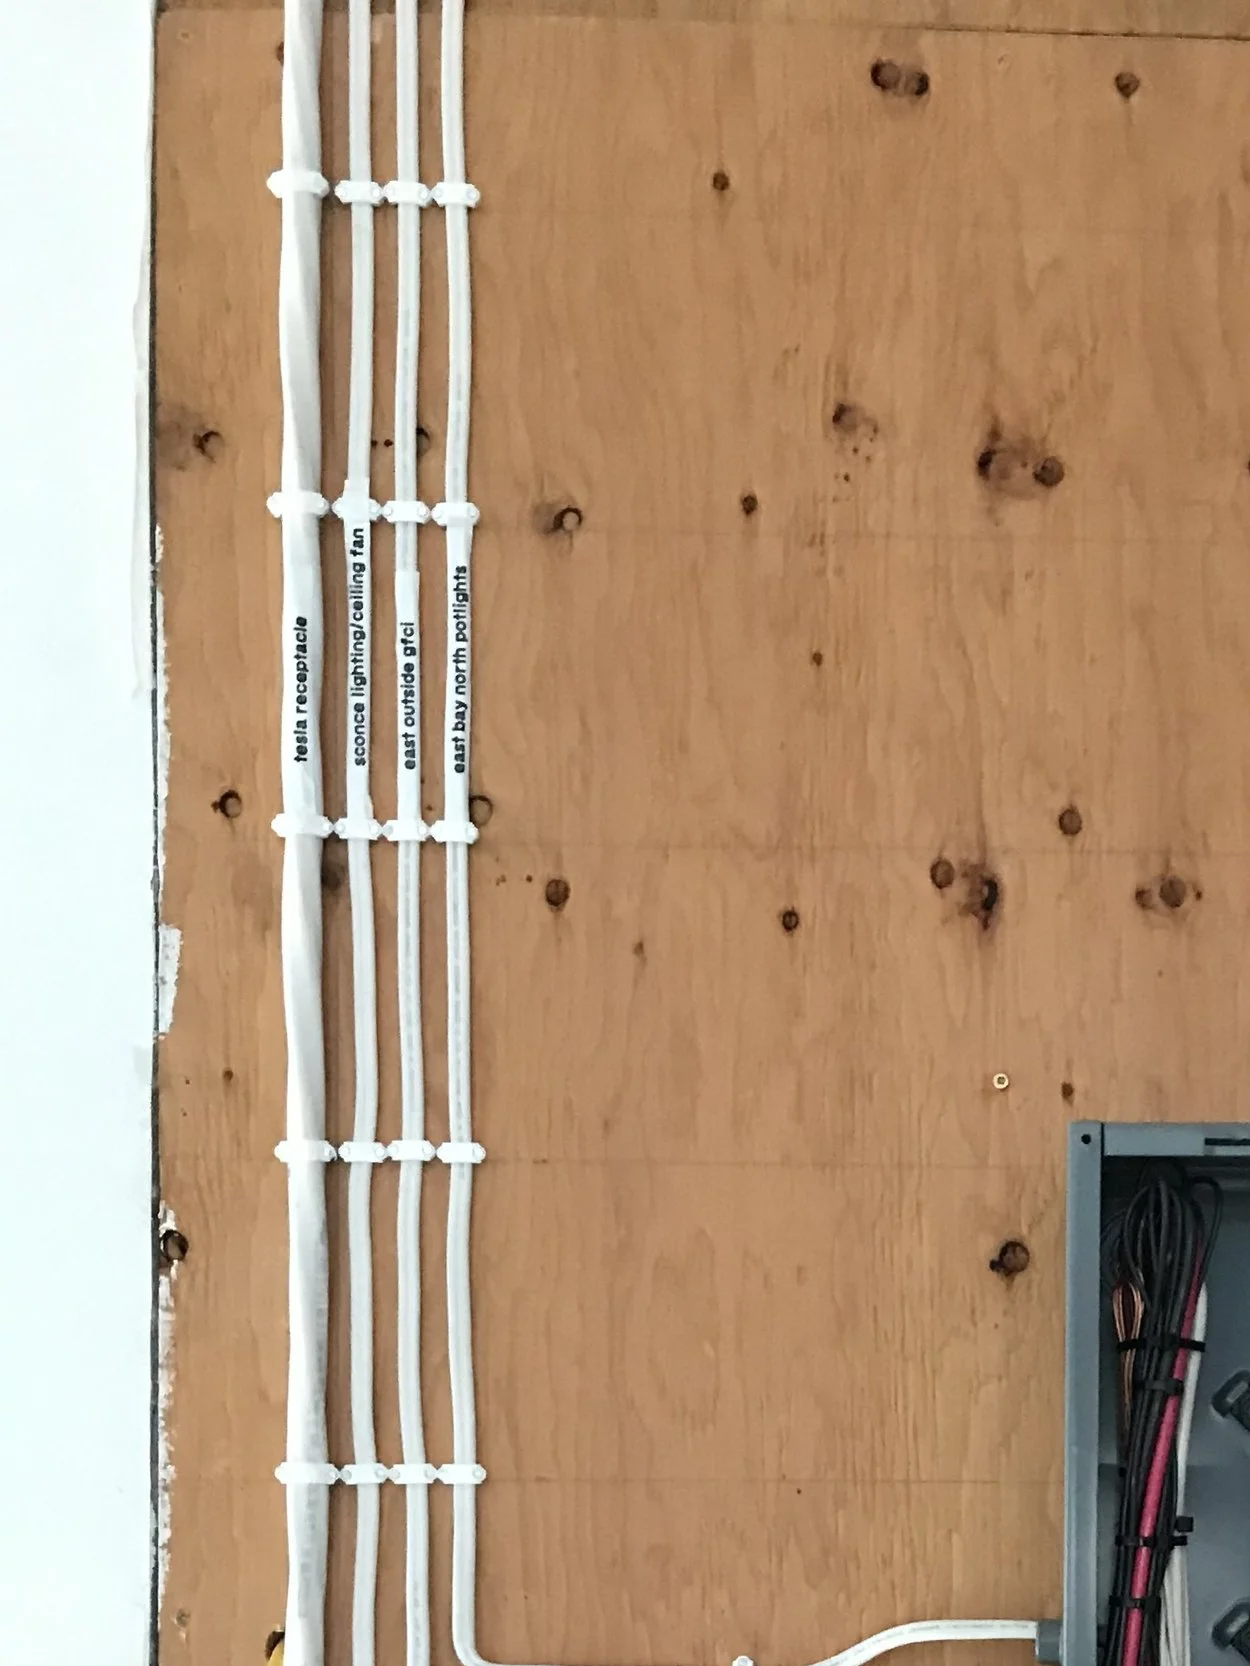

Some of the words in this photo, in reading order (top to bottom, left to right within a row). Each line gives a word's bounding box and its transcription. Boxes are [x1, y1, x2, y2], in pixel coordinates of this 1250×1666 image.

[350, 528, 364, 556] fan
[453, 564, 471, 642] potlights
[348, 563, 366, 696] lighting/ceiling
[400, 621, 416, 656] gfci
[294, 617, 309, 713] receptacle
[453, 648, 466, 695] north
[400, 663, 415, 727] outside
[452, 701, 468, 731] bay
[294, 719, 308, 763] tesla
[354, 703, 366, 766] sconce
[402, 732, 416, 769] east
[452, 737, 465, 773] east
